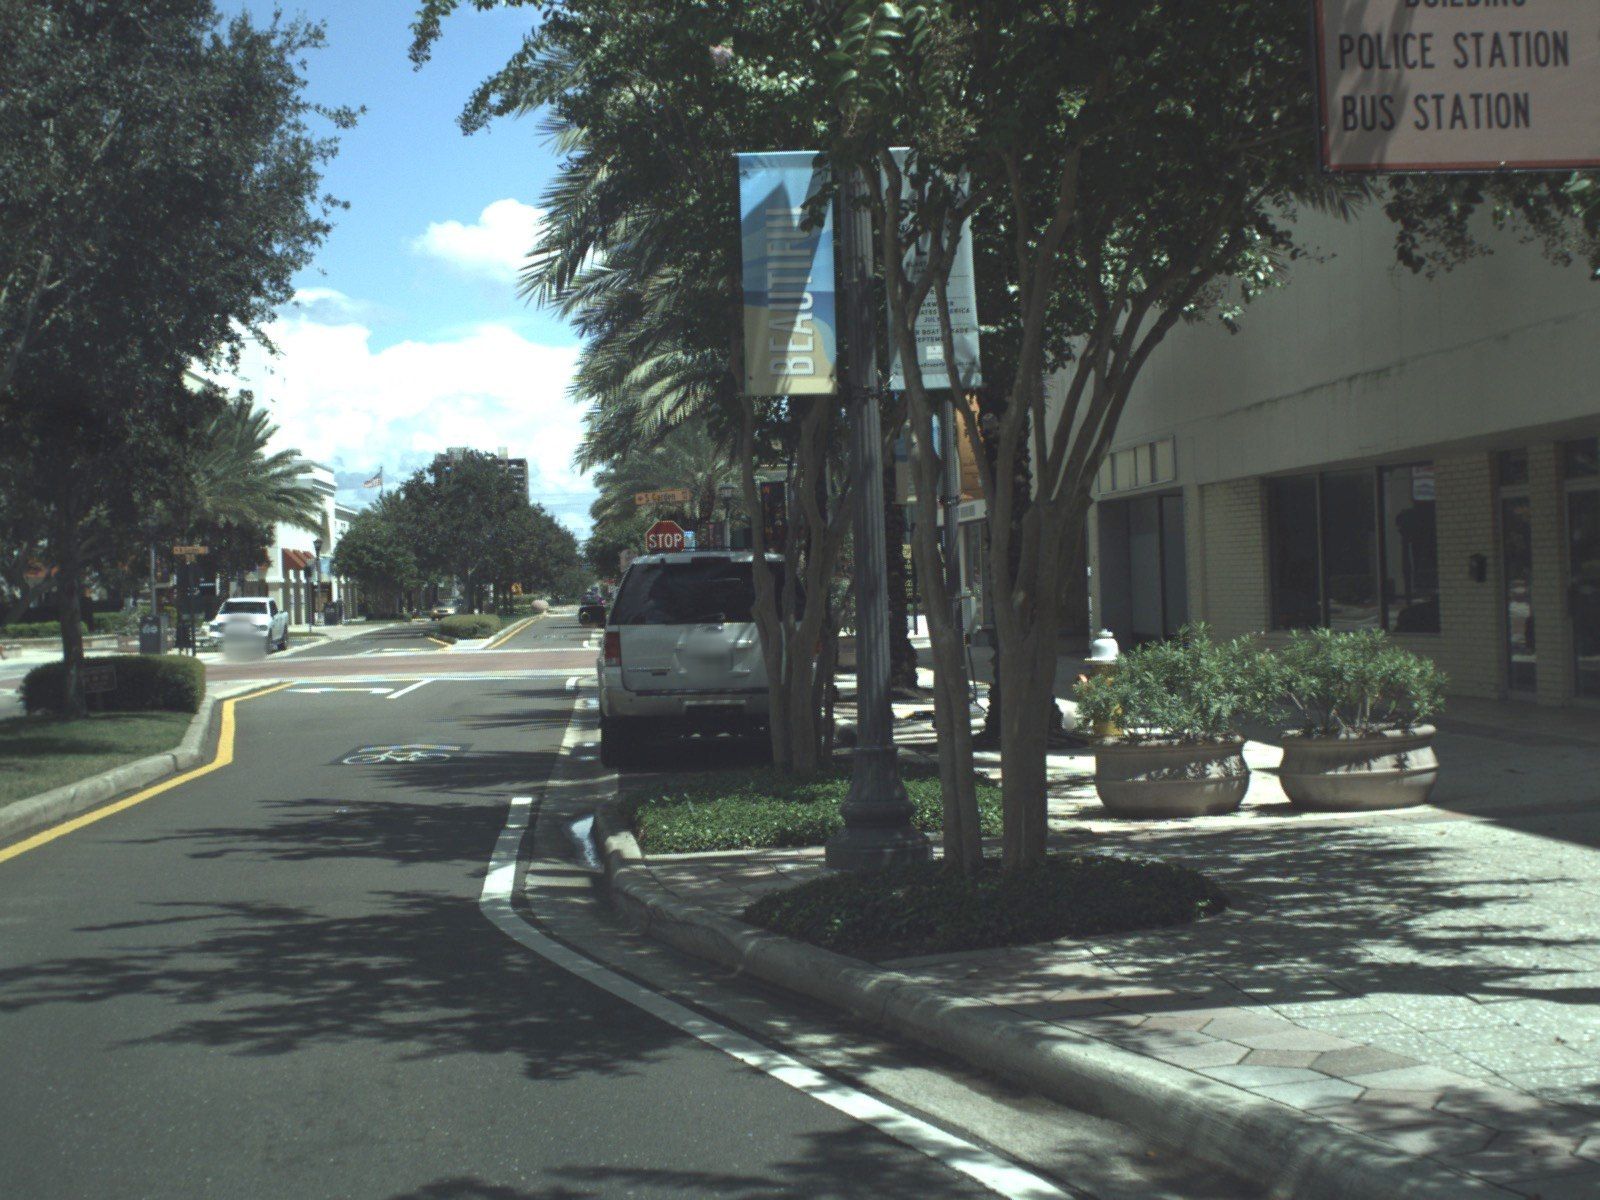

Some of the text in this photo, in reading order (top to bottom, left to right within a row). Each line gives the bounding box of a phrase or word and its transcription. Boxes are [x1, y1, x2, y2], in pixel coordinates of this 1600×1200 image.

[1338, 30, 1569, 70] POLICE STATION
[1341, 92, 1531, 131] BUS STATION
[649, 533, 682, 549] STOP
